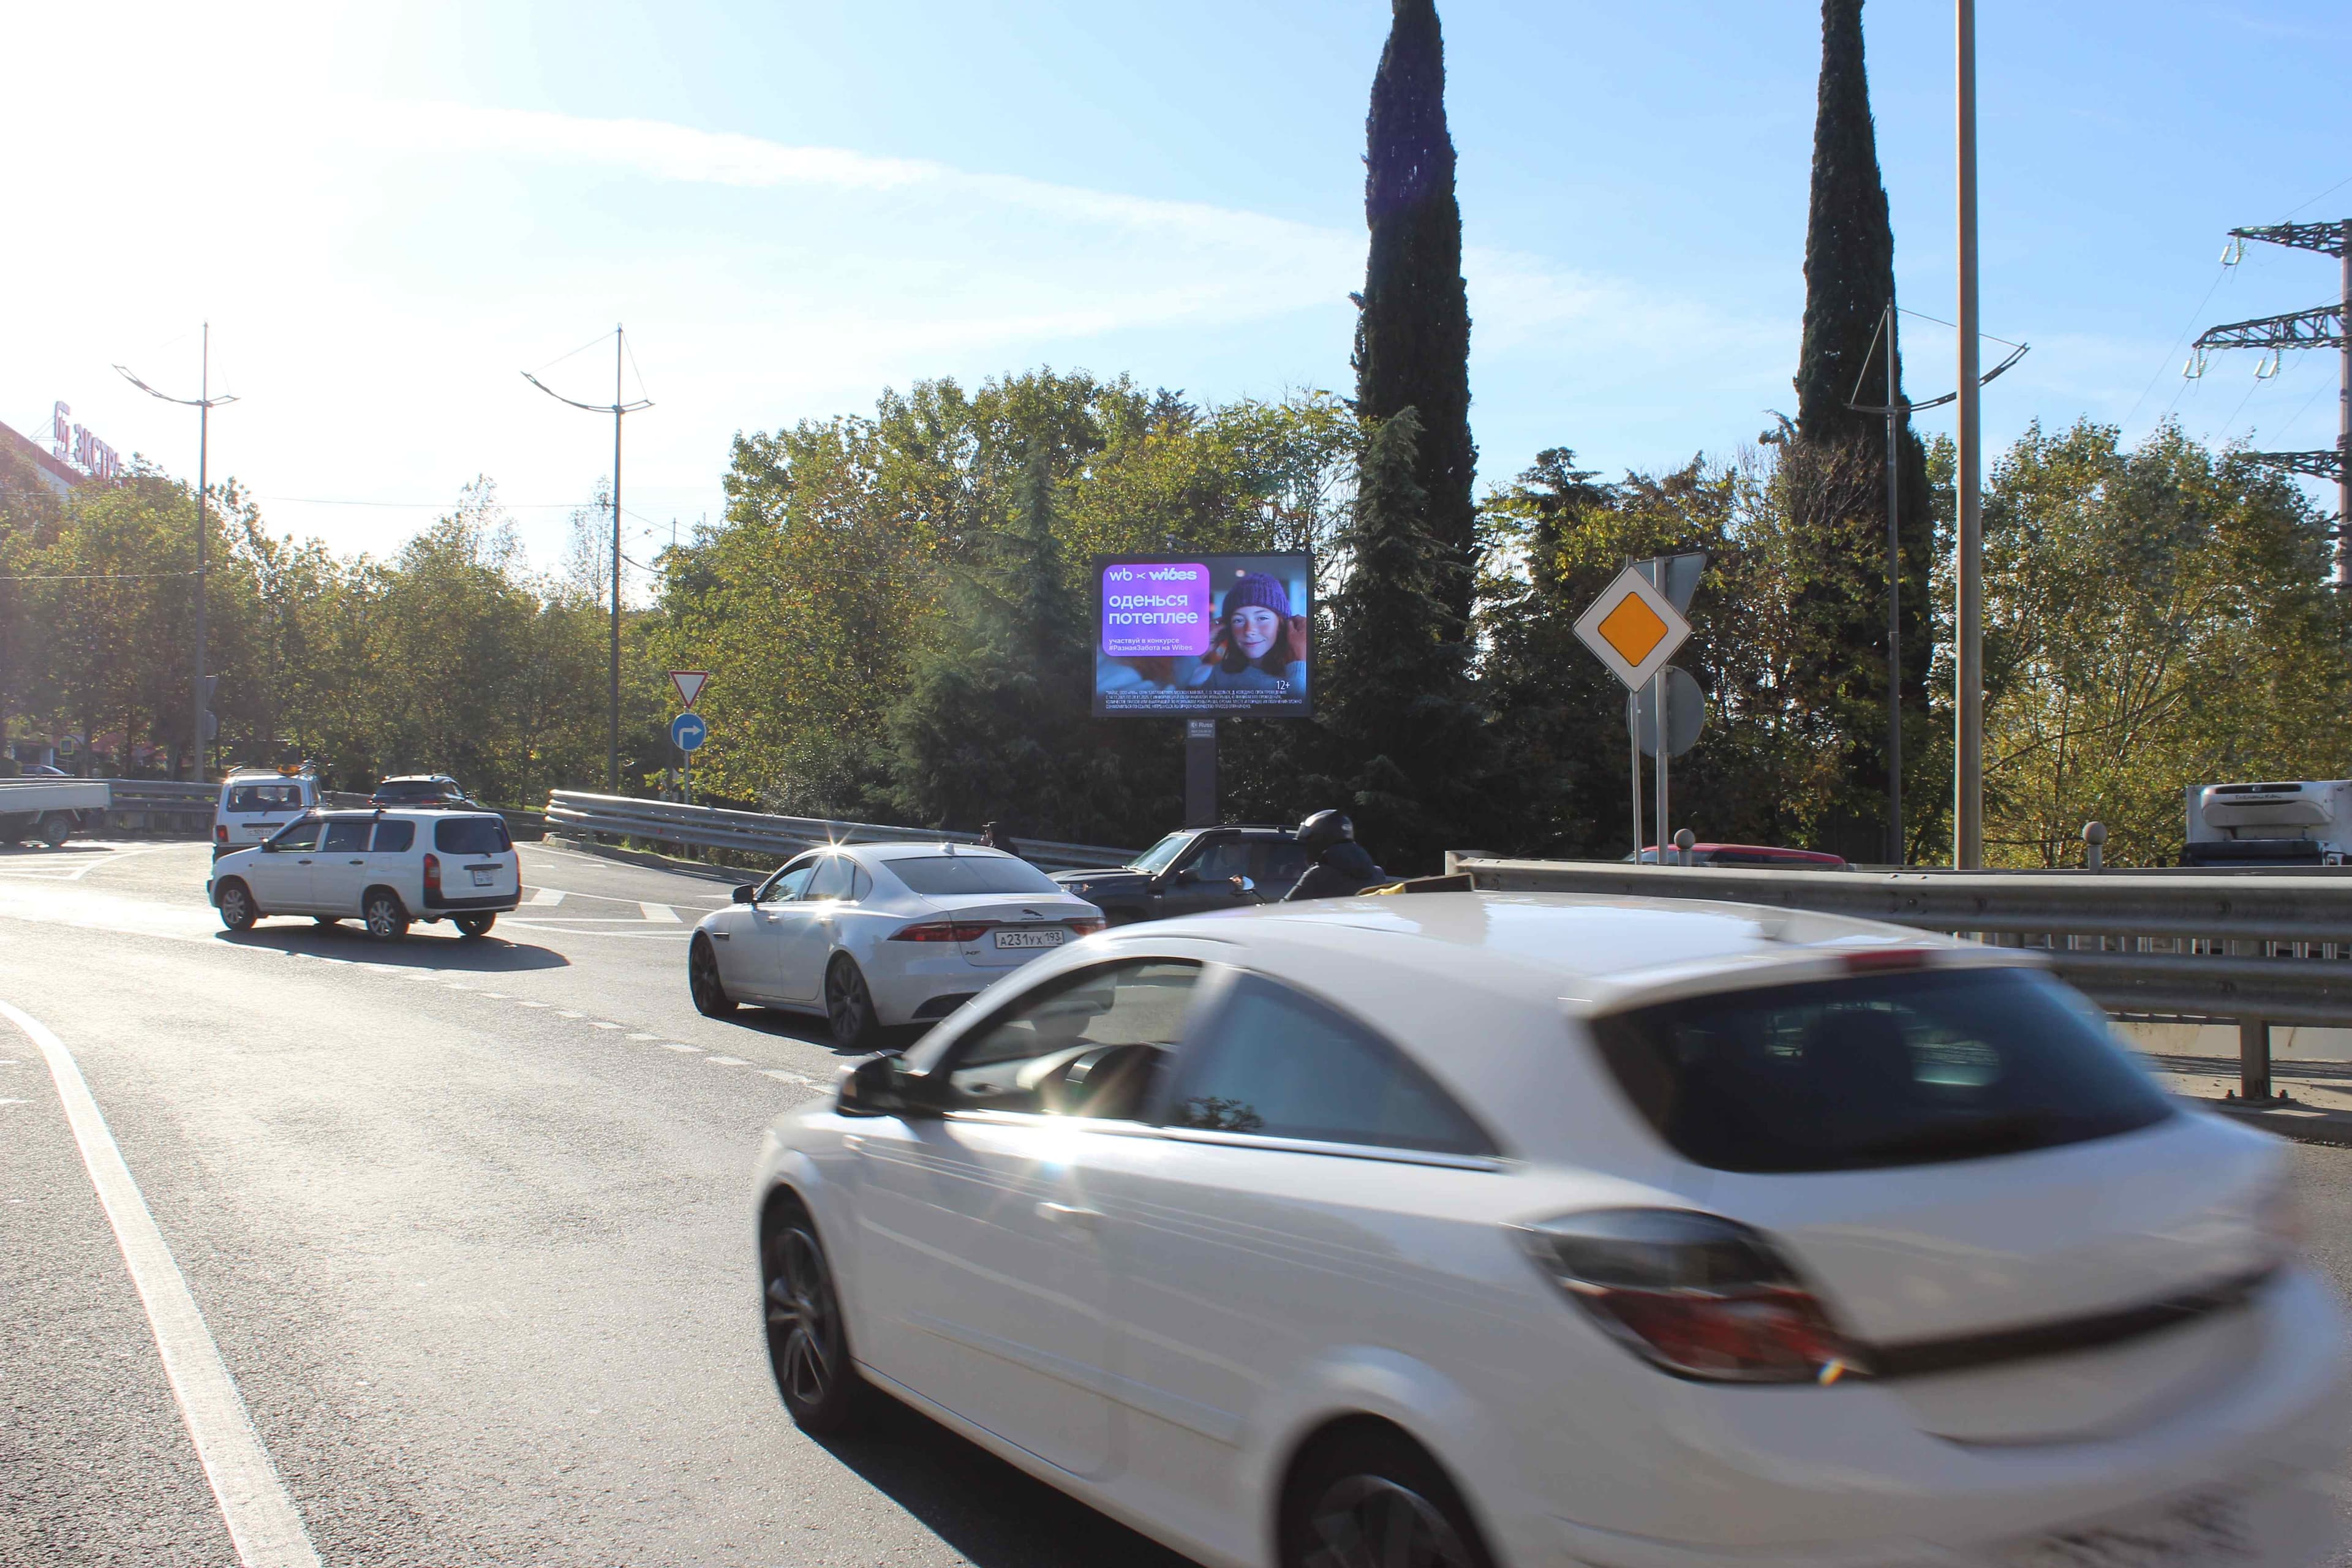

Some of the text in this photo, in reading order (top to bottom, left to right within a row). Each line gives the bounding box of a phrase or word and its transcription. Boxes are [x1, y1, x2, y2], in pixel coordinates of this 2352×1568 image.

[1109, 567, 1133, 581] wb
[1109, 595, 1188, 609] оденься
[1109, 612, 1198, 625] потеплее
[1276, 680, 1291, 690] 12+
[1044, 932, 1060, 941] 193
